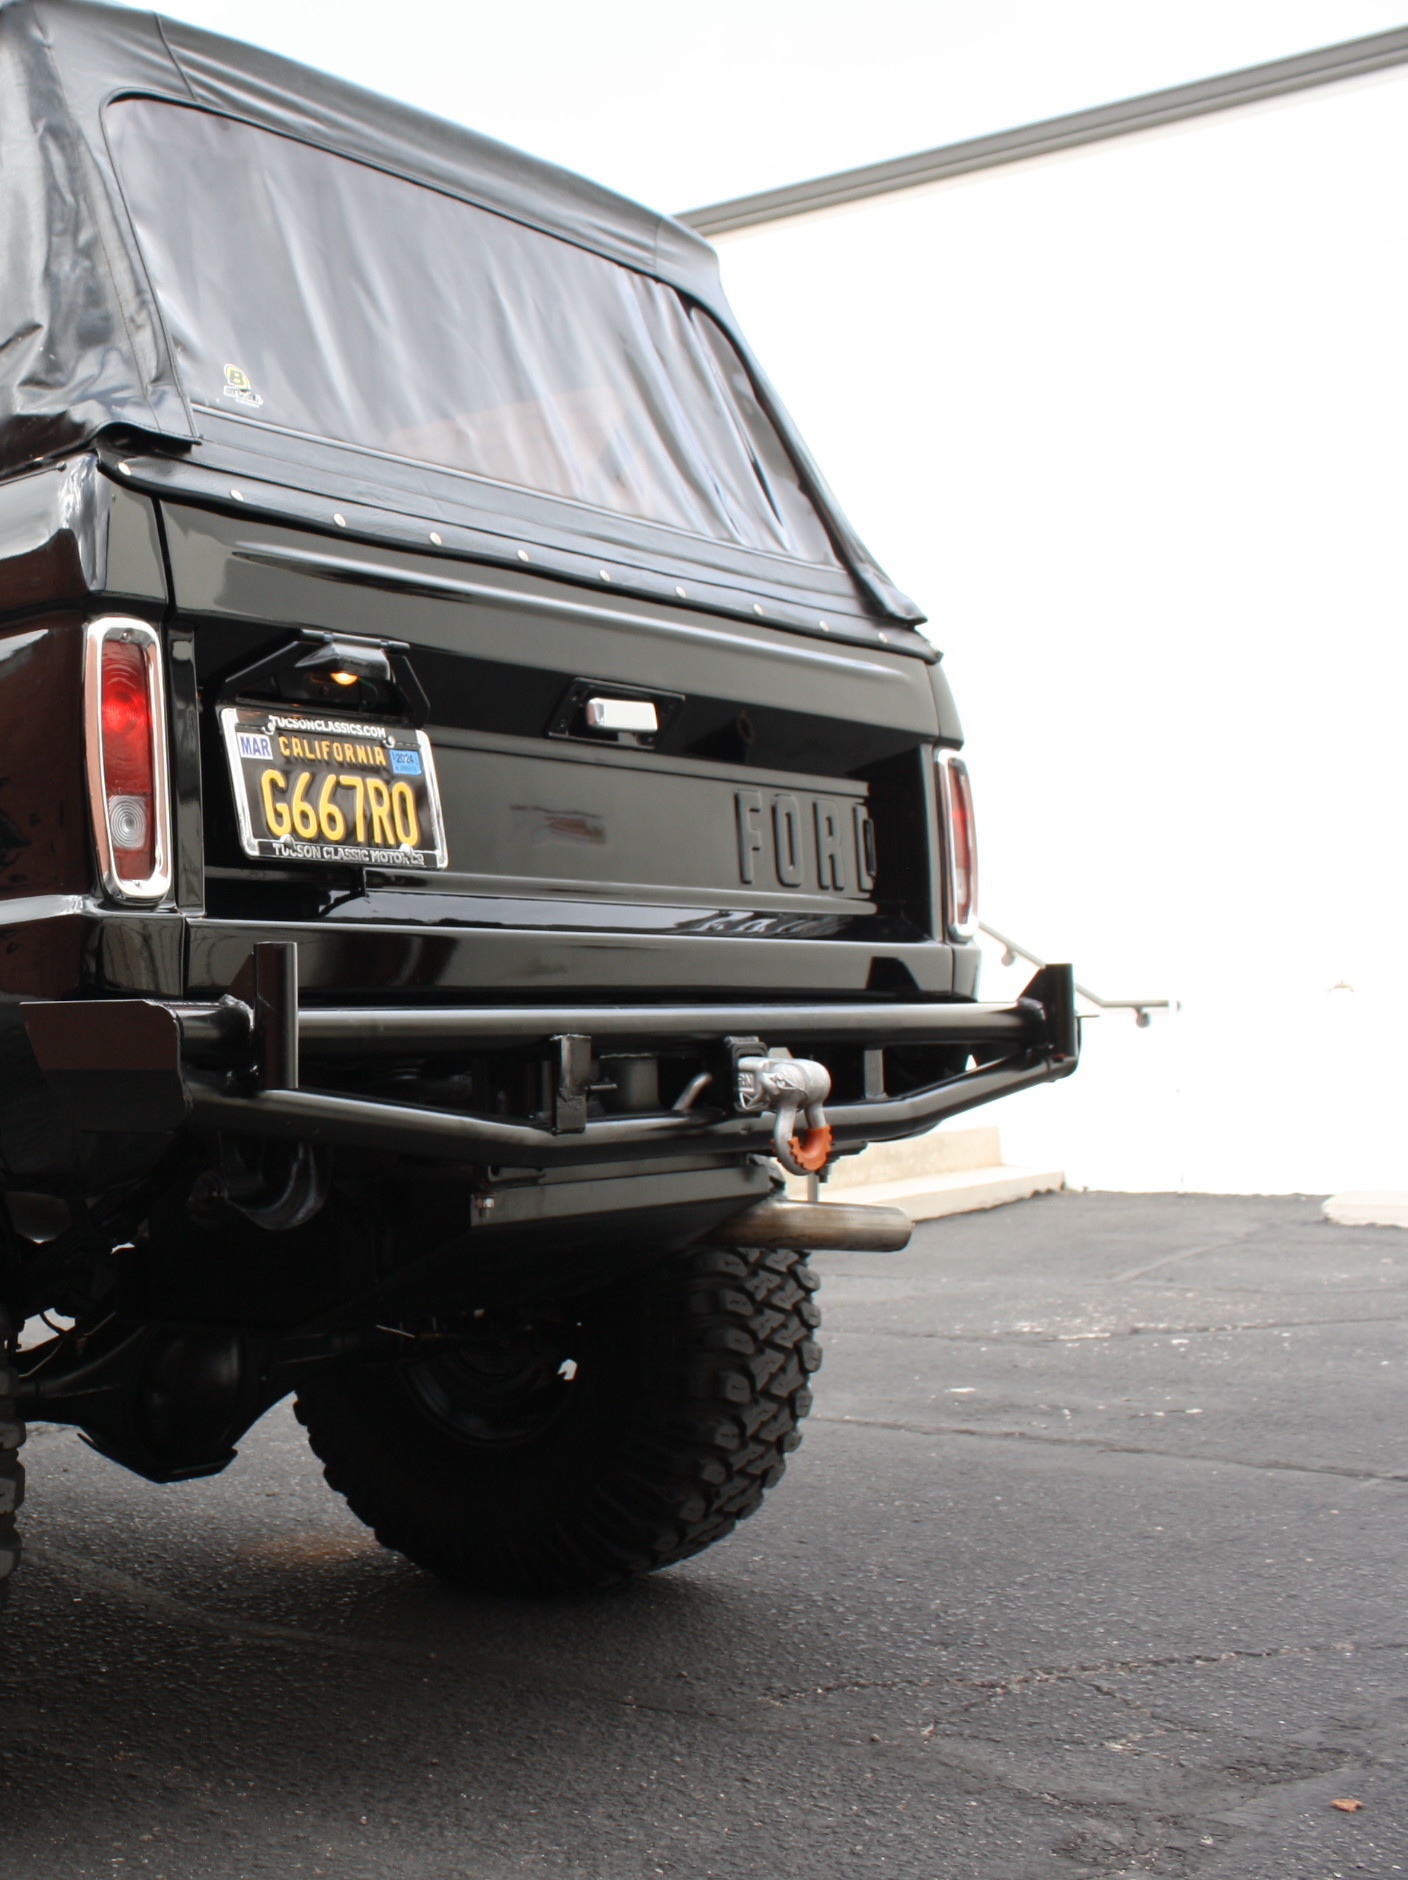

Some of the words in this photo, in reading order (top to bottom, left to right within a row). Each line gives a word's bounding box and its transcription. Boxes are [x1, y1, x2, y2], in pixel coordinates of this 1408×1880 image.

[269, 715, 386, 738] TUCSONCLASSICS.COM
[241, 736, 271, 757] MAR
[278, 735, 387, 766] CALIFORNIA
[734, 789, 877, 892] FORD
[322, 846, 369, 862] CLASSIC
